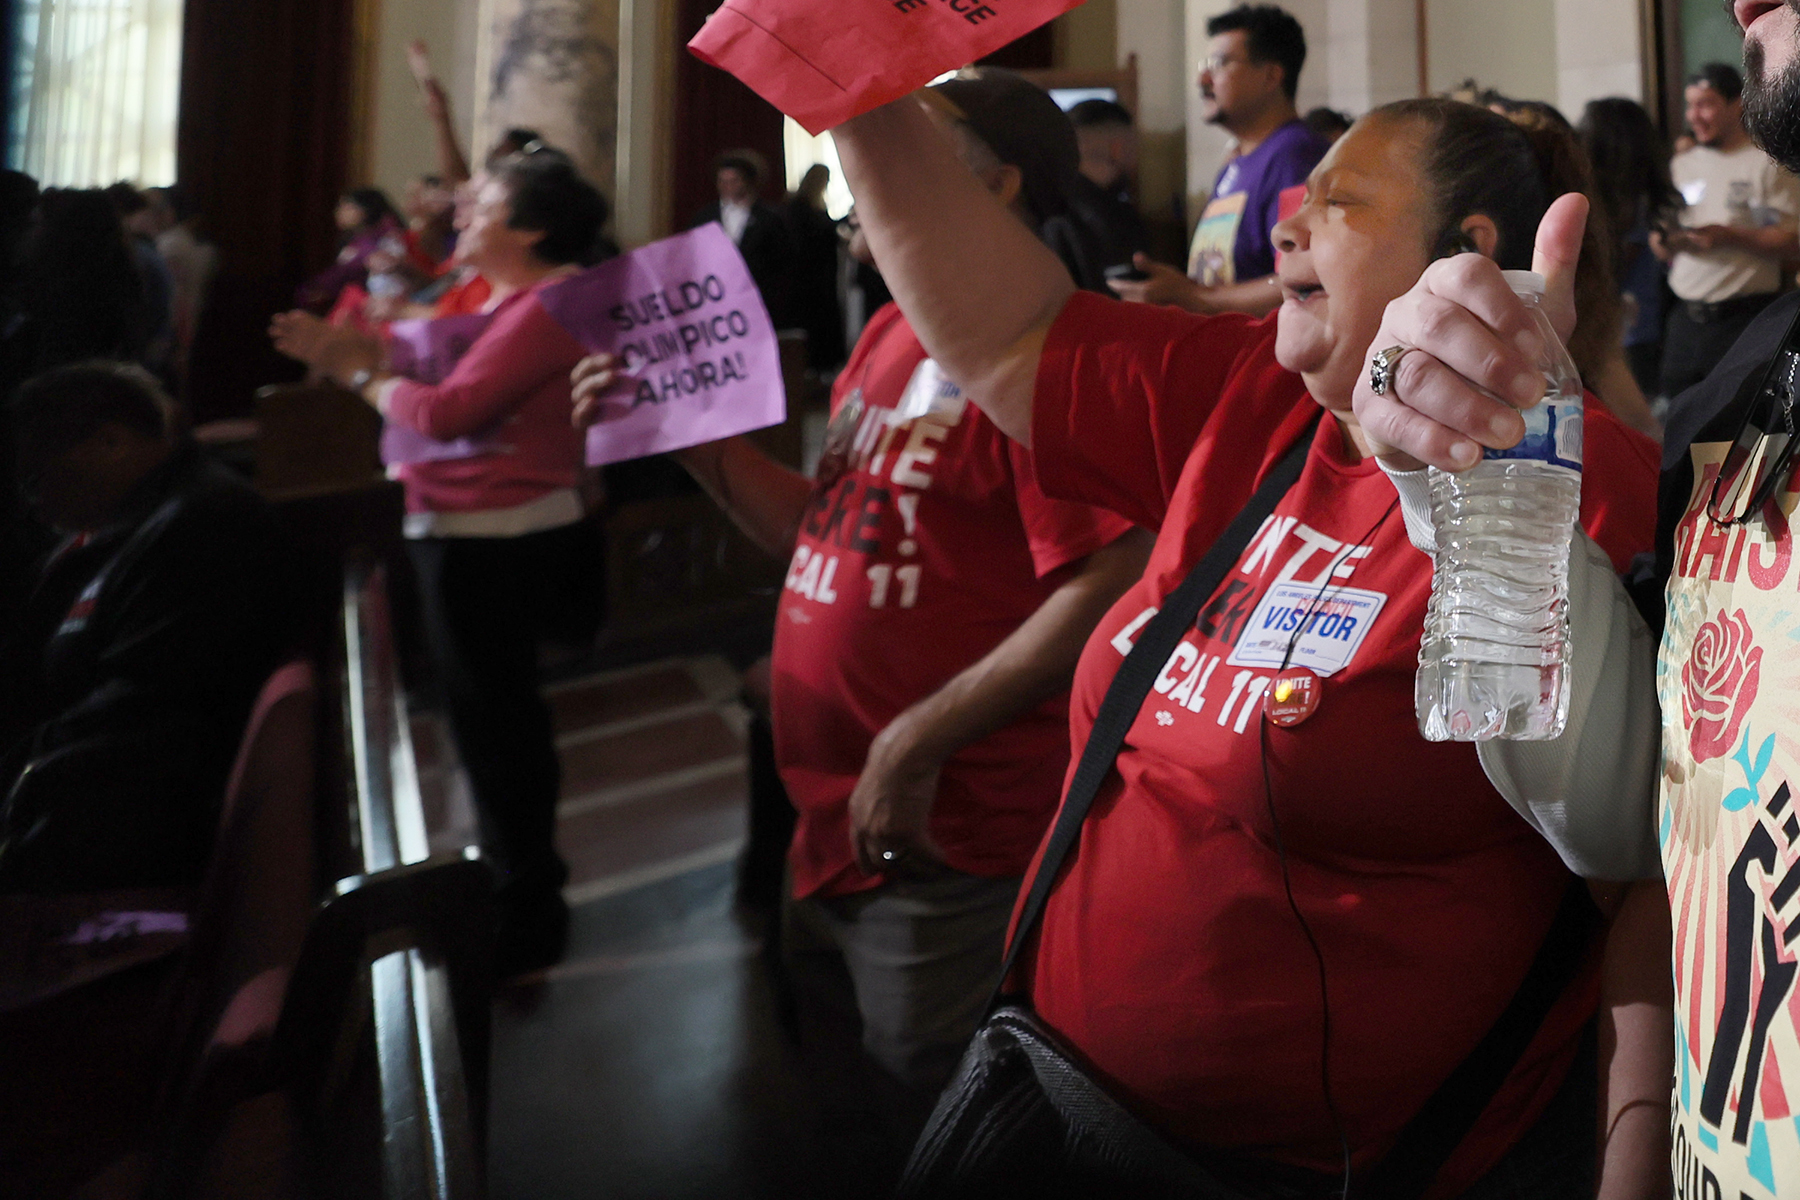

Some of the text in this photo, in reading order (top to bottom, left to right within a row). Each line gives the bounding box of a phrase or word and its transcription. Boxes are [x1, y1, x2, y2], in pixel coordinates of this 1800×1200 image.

[608, 274, 726, 332] SUELDO
[867, 564, 922, 608] 11
[1262, 605, 1358, 643] VISTOR
[1110, 606, 1272, 735] LCAL 11
